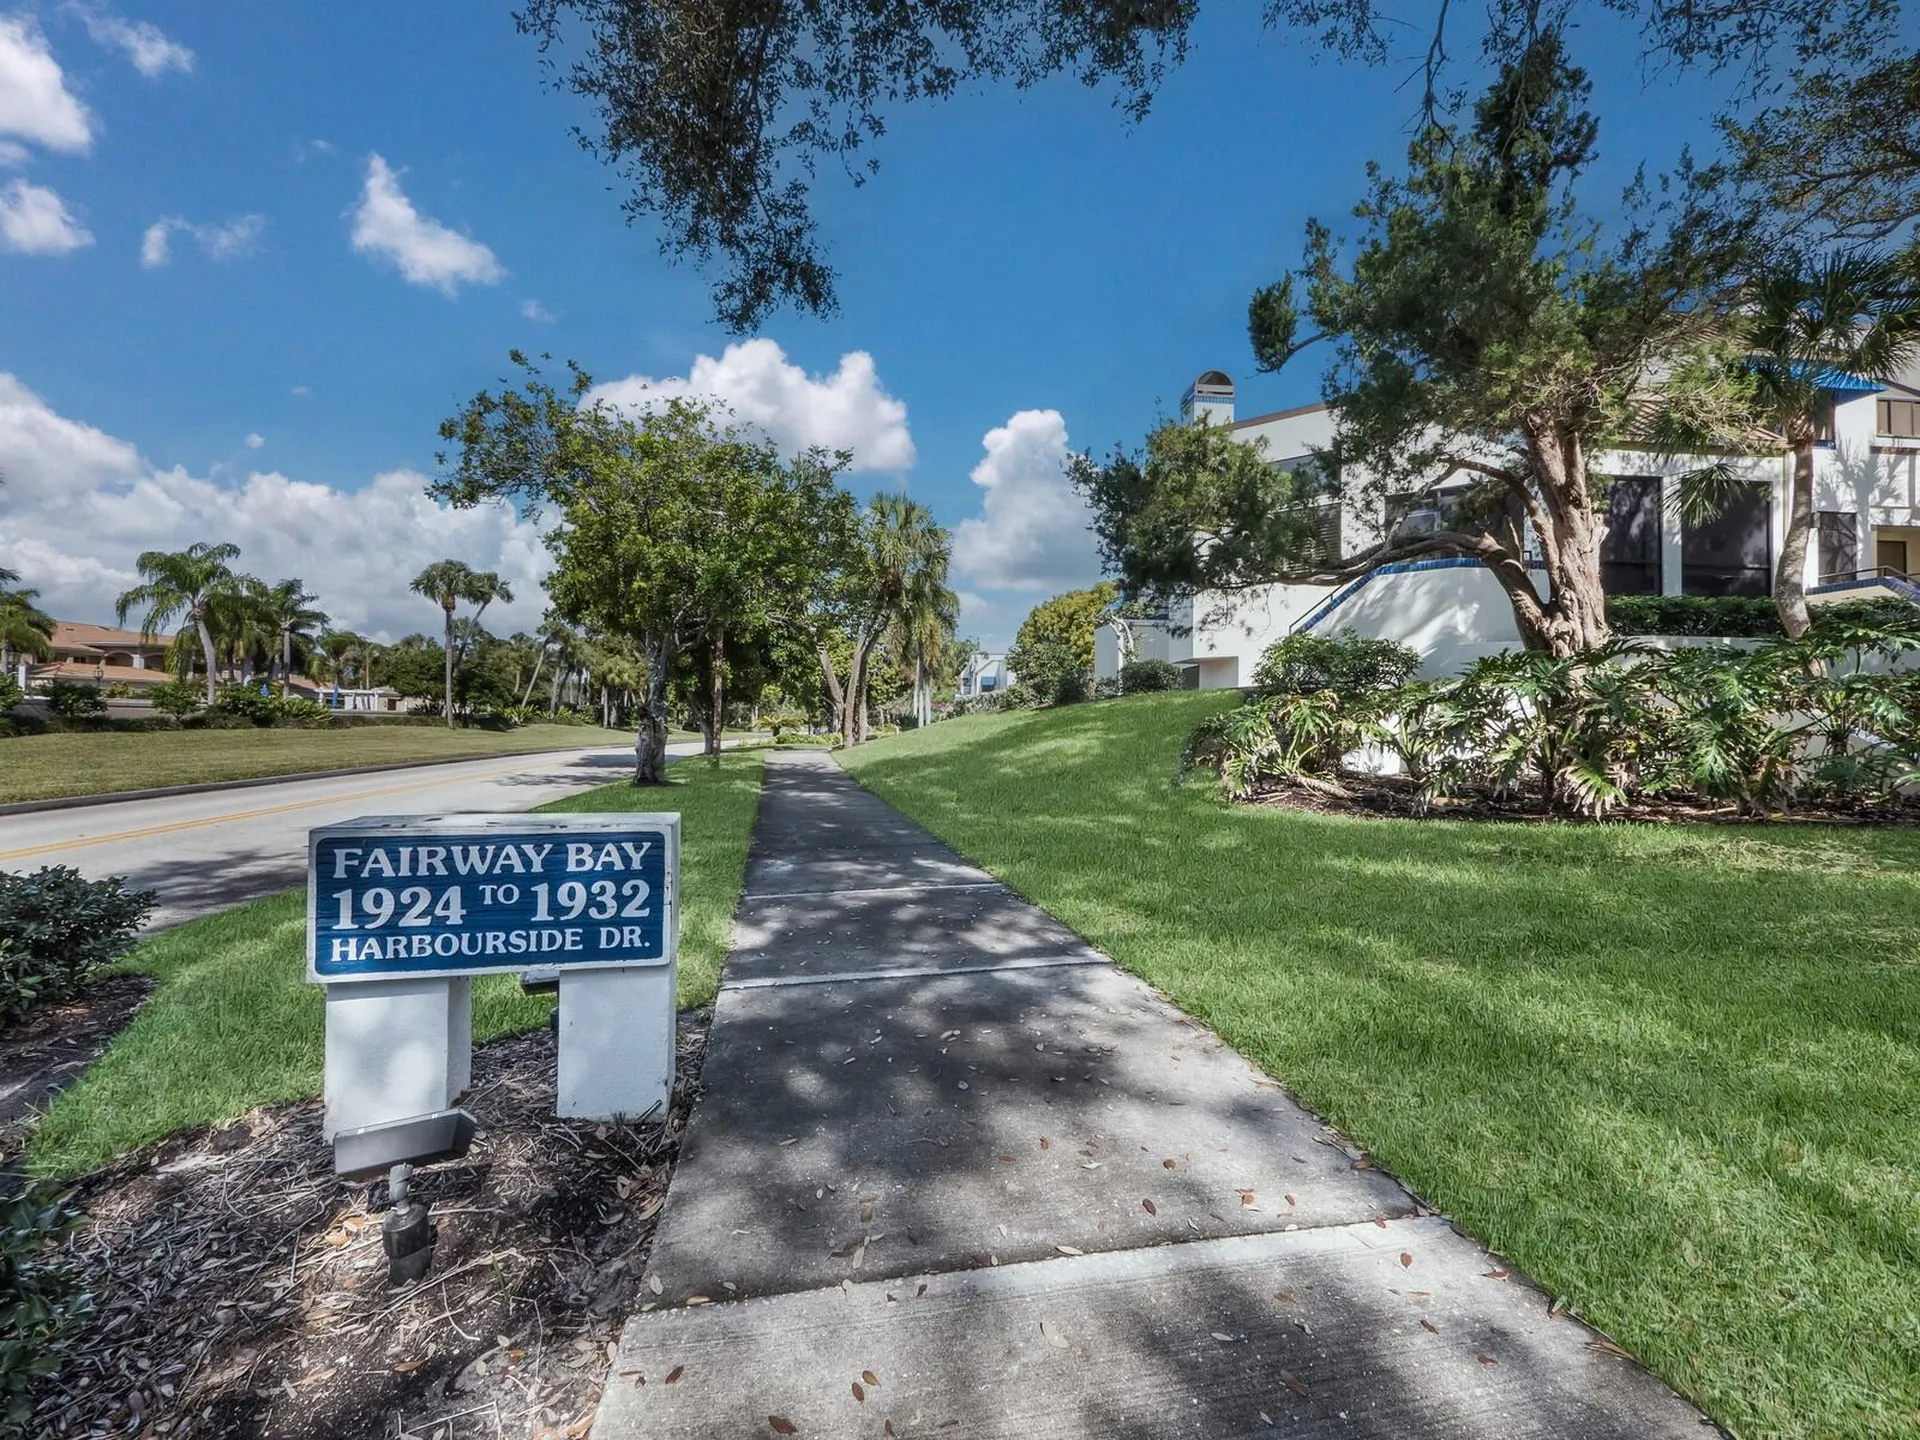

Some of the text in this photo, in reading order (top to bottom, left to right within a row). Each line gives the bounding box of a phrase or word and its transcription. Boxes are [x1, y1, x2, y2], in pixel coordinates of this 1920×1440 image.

[333, 841, 652, 878] FAIRWAY BAY
[332, 879, 651, 930] 1924 TO 1932
[331, 925, 651, 962] HARBOURSIDE DR.
